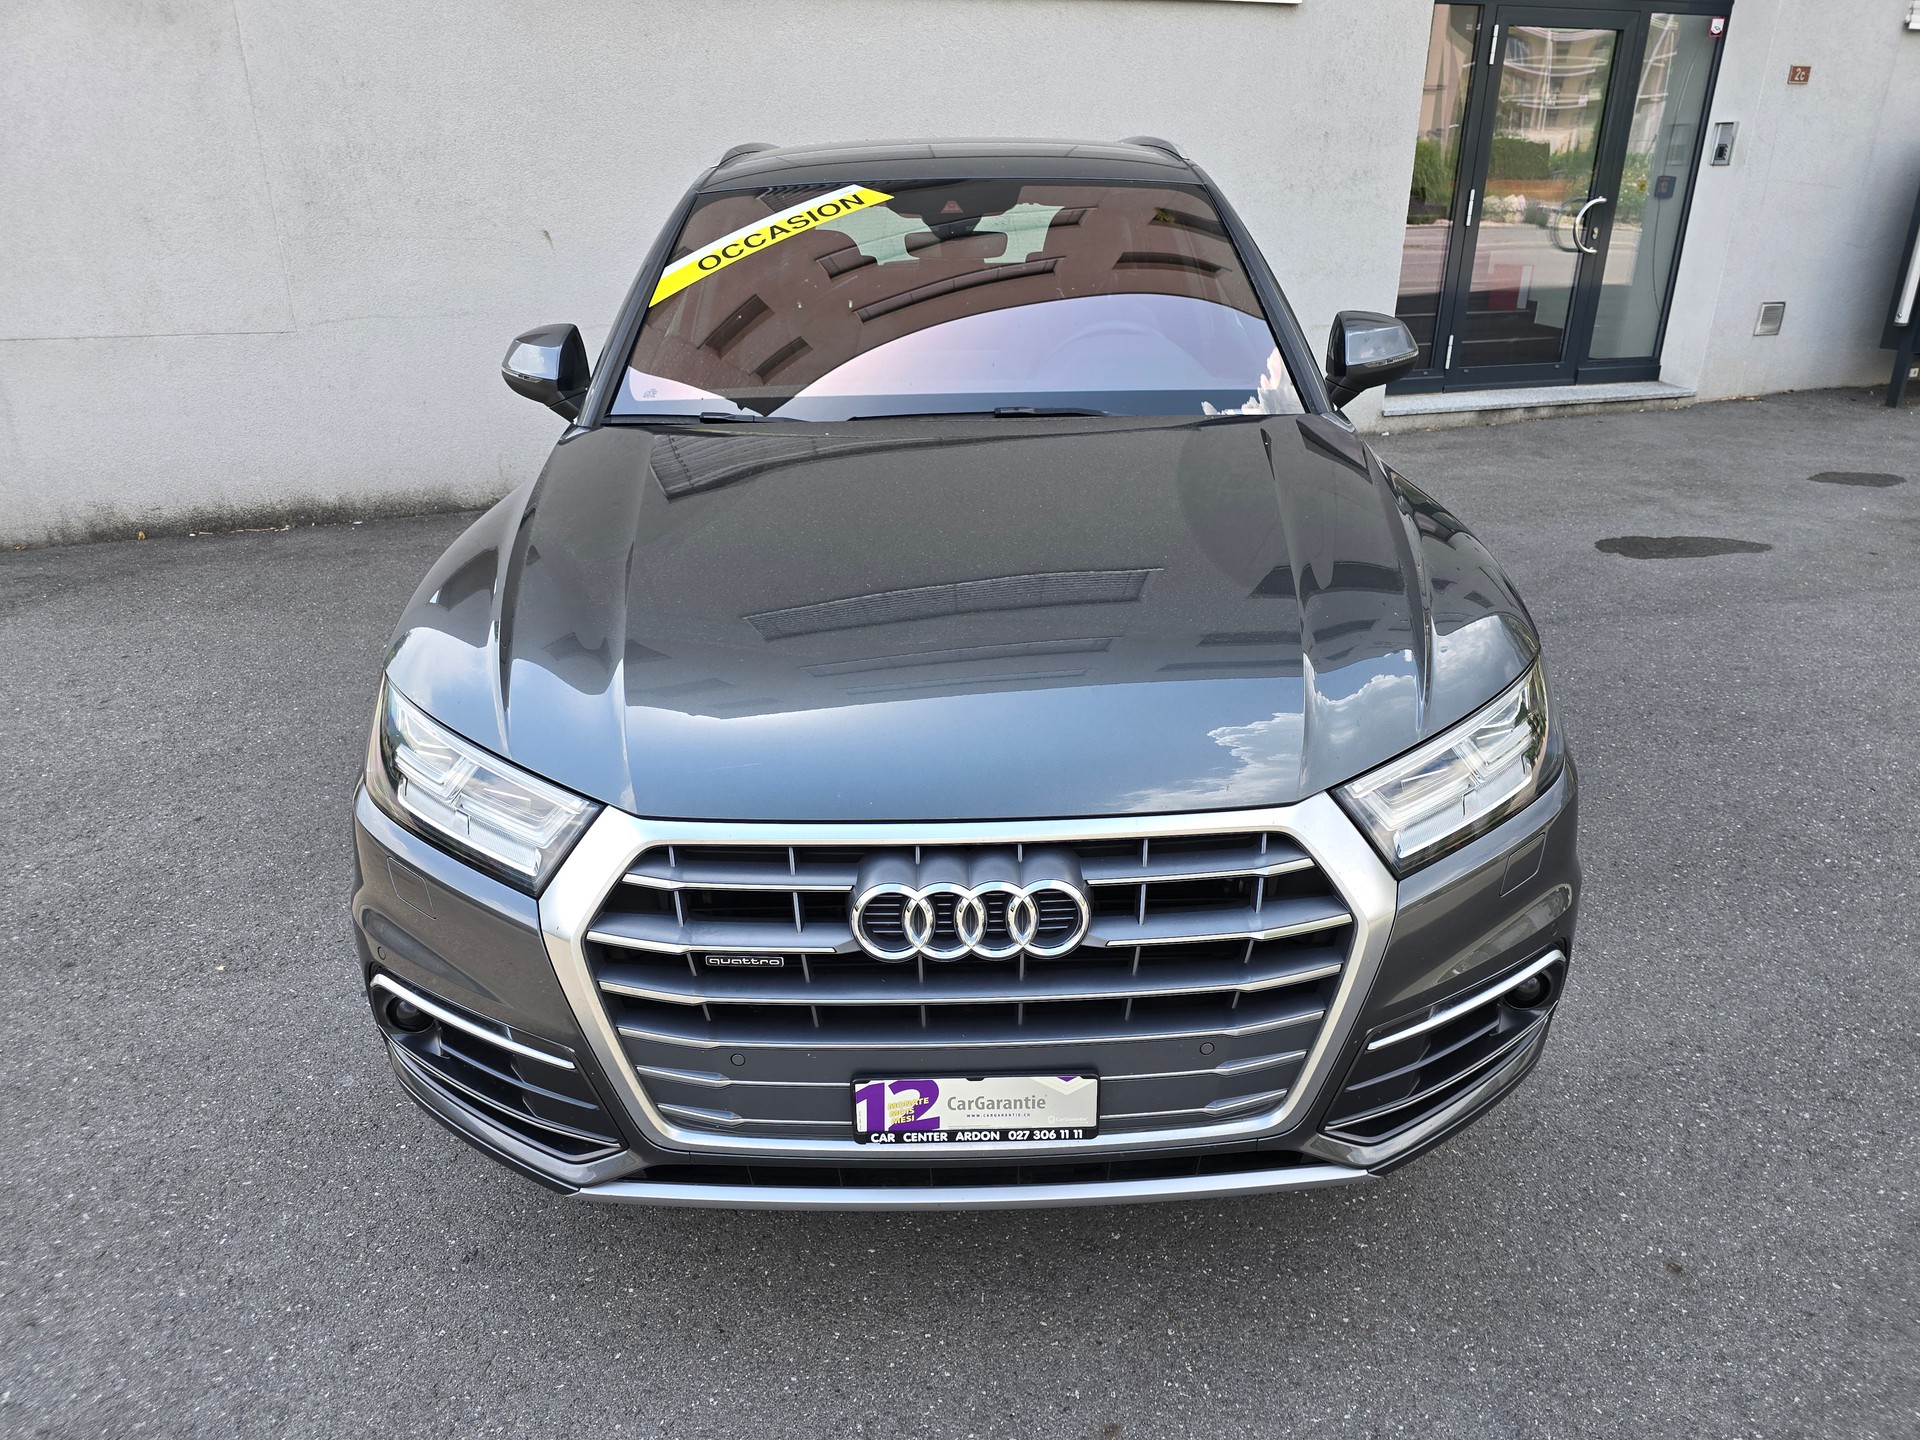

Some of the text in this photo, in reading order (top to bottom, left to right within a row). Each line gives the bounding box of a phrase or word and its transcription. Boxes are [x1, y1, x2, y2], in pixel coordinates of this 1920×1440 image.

[1794, 67, 1806, 81] 2c
[697, 193, 865, 271] OCCASION
[855, 1080, 941, 1132] 12
[888, 1097, 930, 1110] MONATE
[947, 1094, 1046, 1111] CarGarantie
[889, 1107, 915, 1117] MOIS
[891, 1115, 915, 1125] MESI
[870, 1129, 1083, 1143] CAR CENTER ARDON 027 306 11 11
